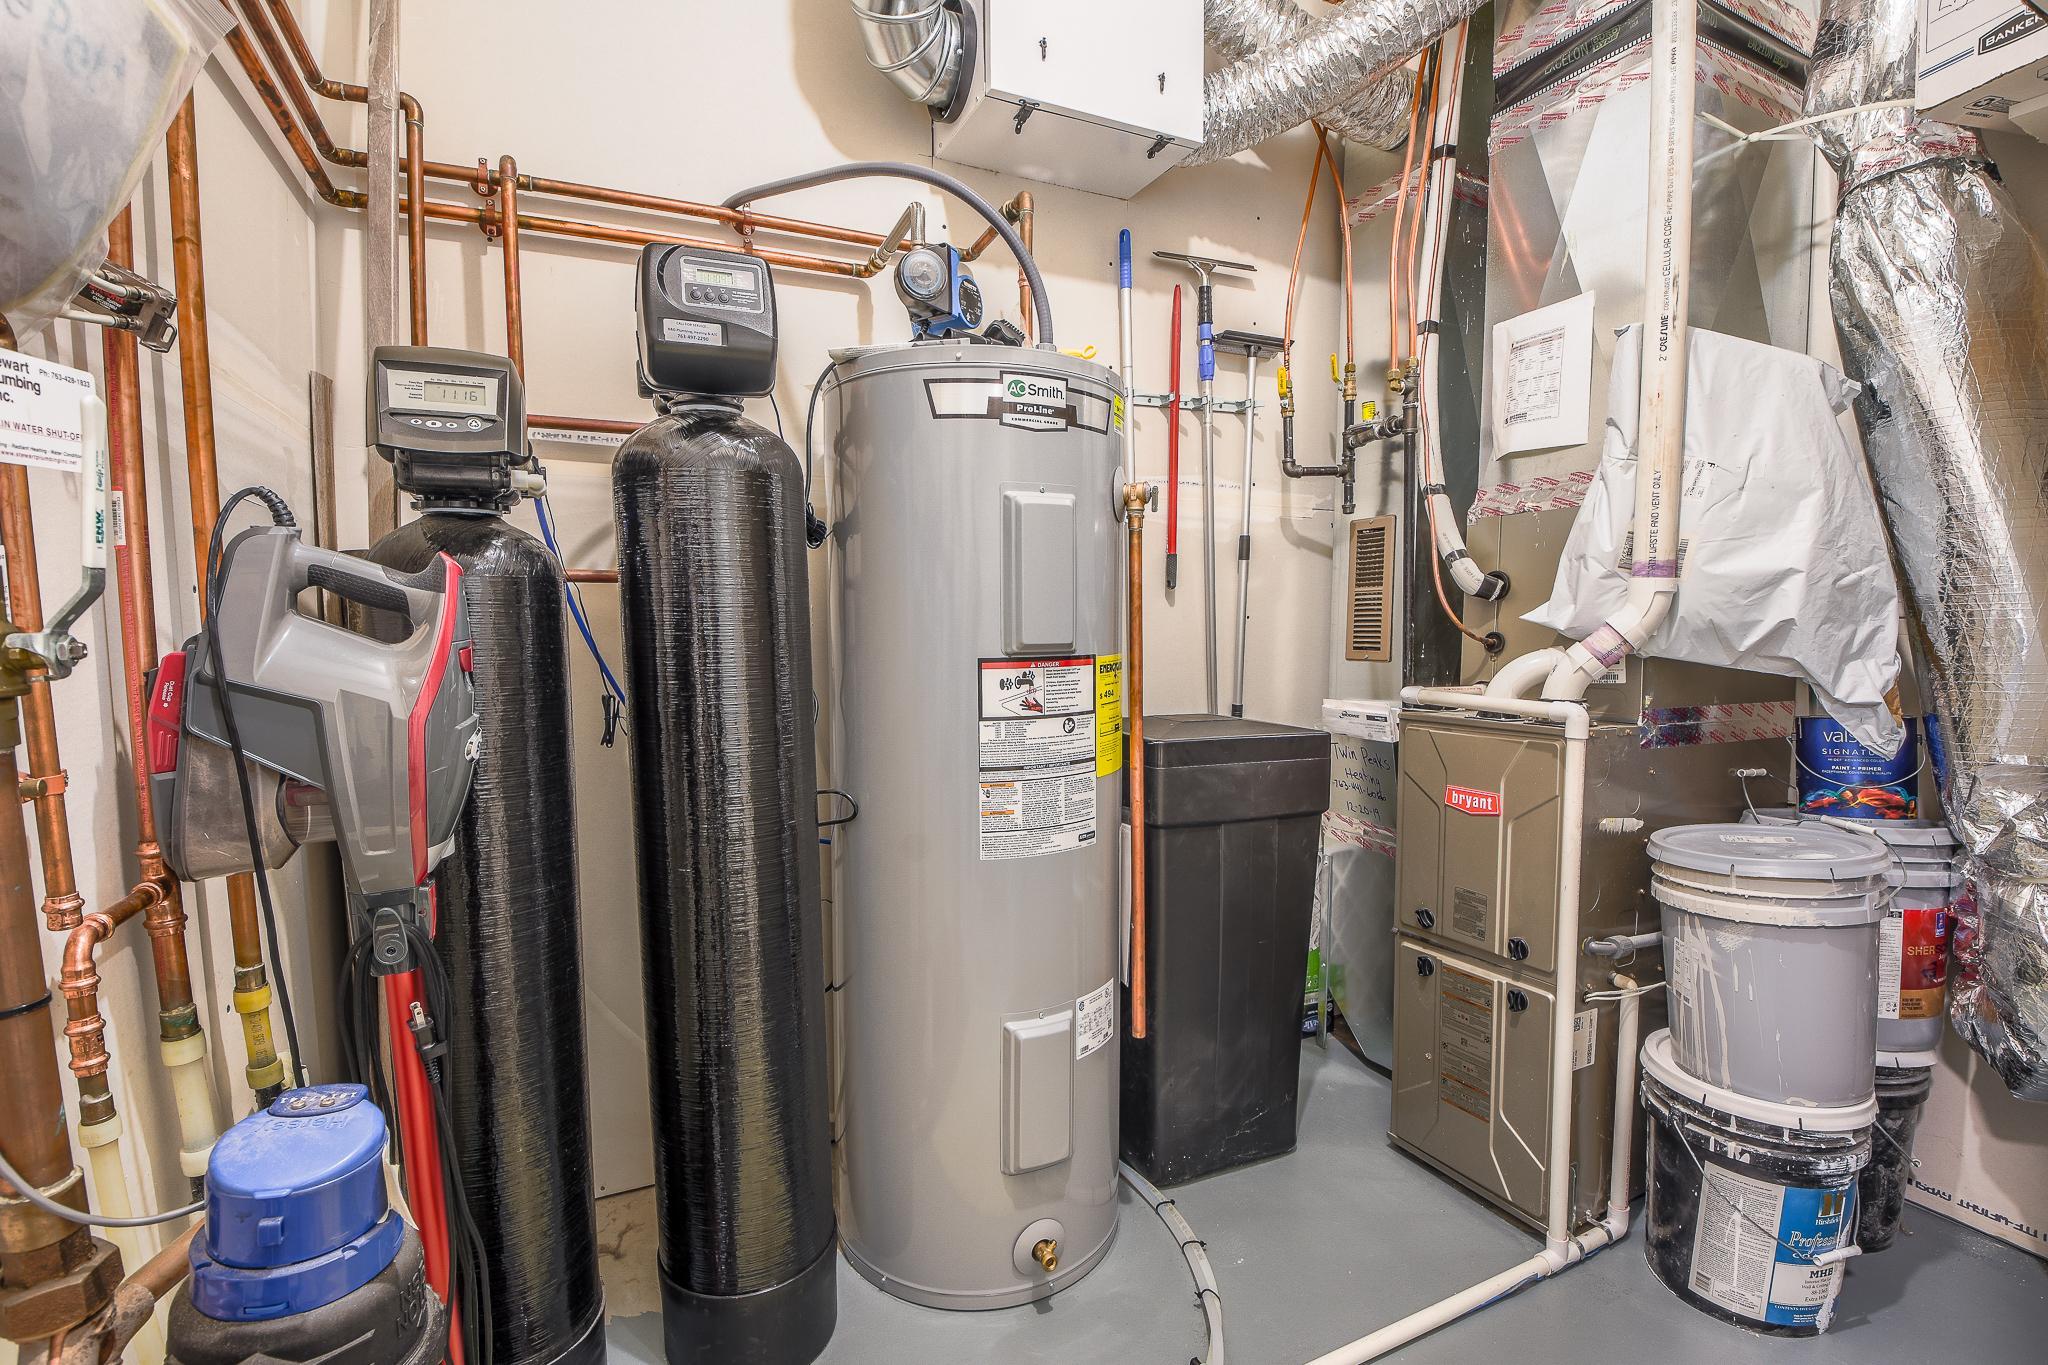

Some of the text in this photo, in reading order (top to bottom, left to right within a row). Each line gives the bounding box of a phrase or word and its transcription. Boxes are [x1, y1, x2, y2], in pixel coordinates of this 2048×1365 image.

[1663, 215, 1672, 236] CORE
[1662, 238, 1672, 276] CELLULAR
[13, 422, 42, 434] WATER
[46, 428, 82, 440] SHUT-OF
[1652, 470, 1662, 490] ONLY
[1651, 491, 1660, 510] VENT
[1650, 512, 1660, 528] AND
[1330, 743, 1391, 770] Twin Peaks
[1345, 768, 1380, 788] Heating
[1452, 791, 1492, 810] bryant
